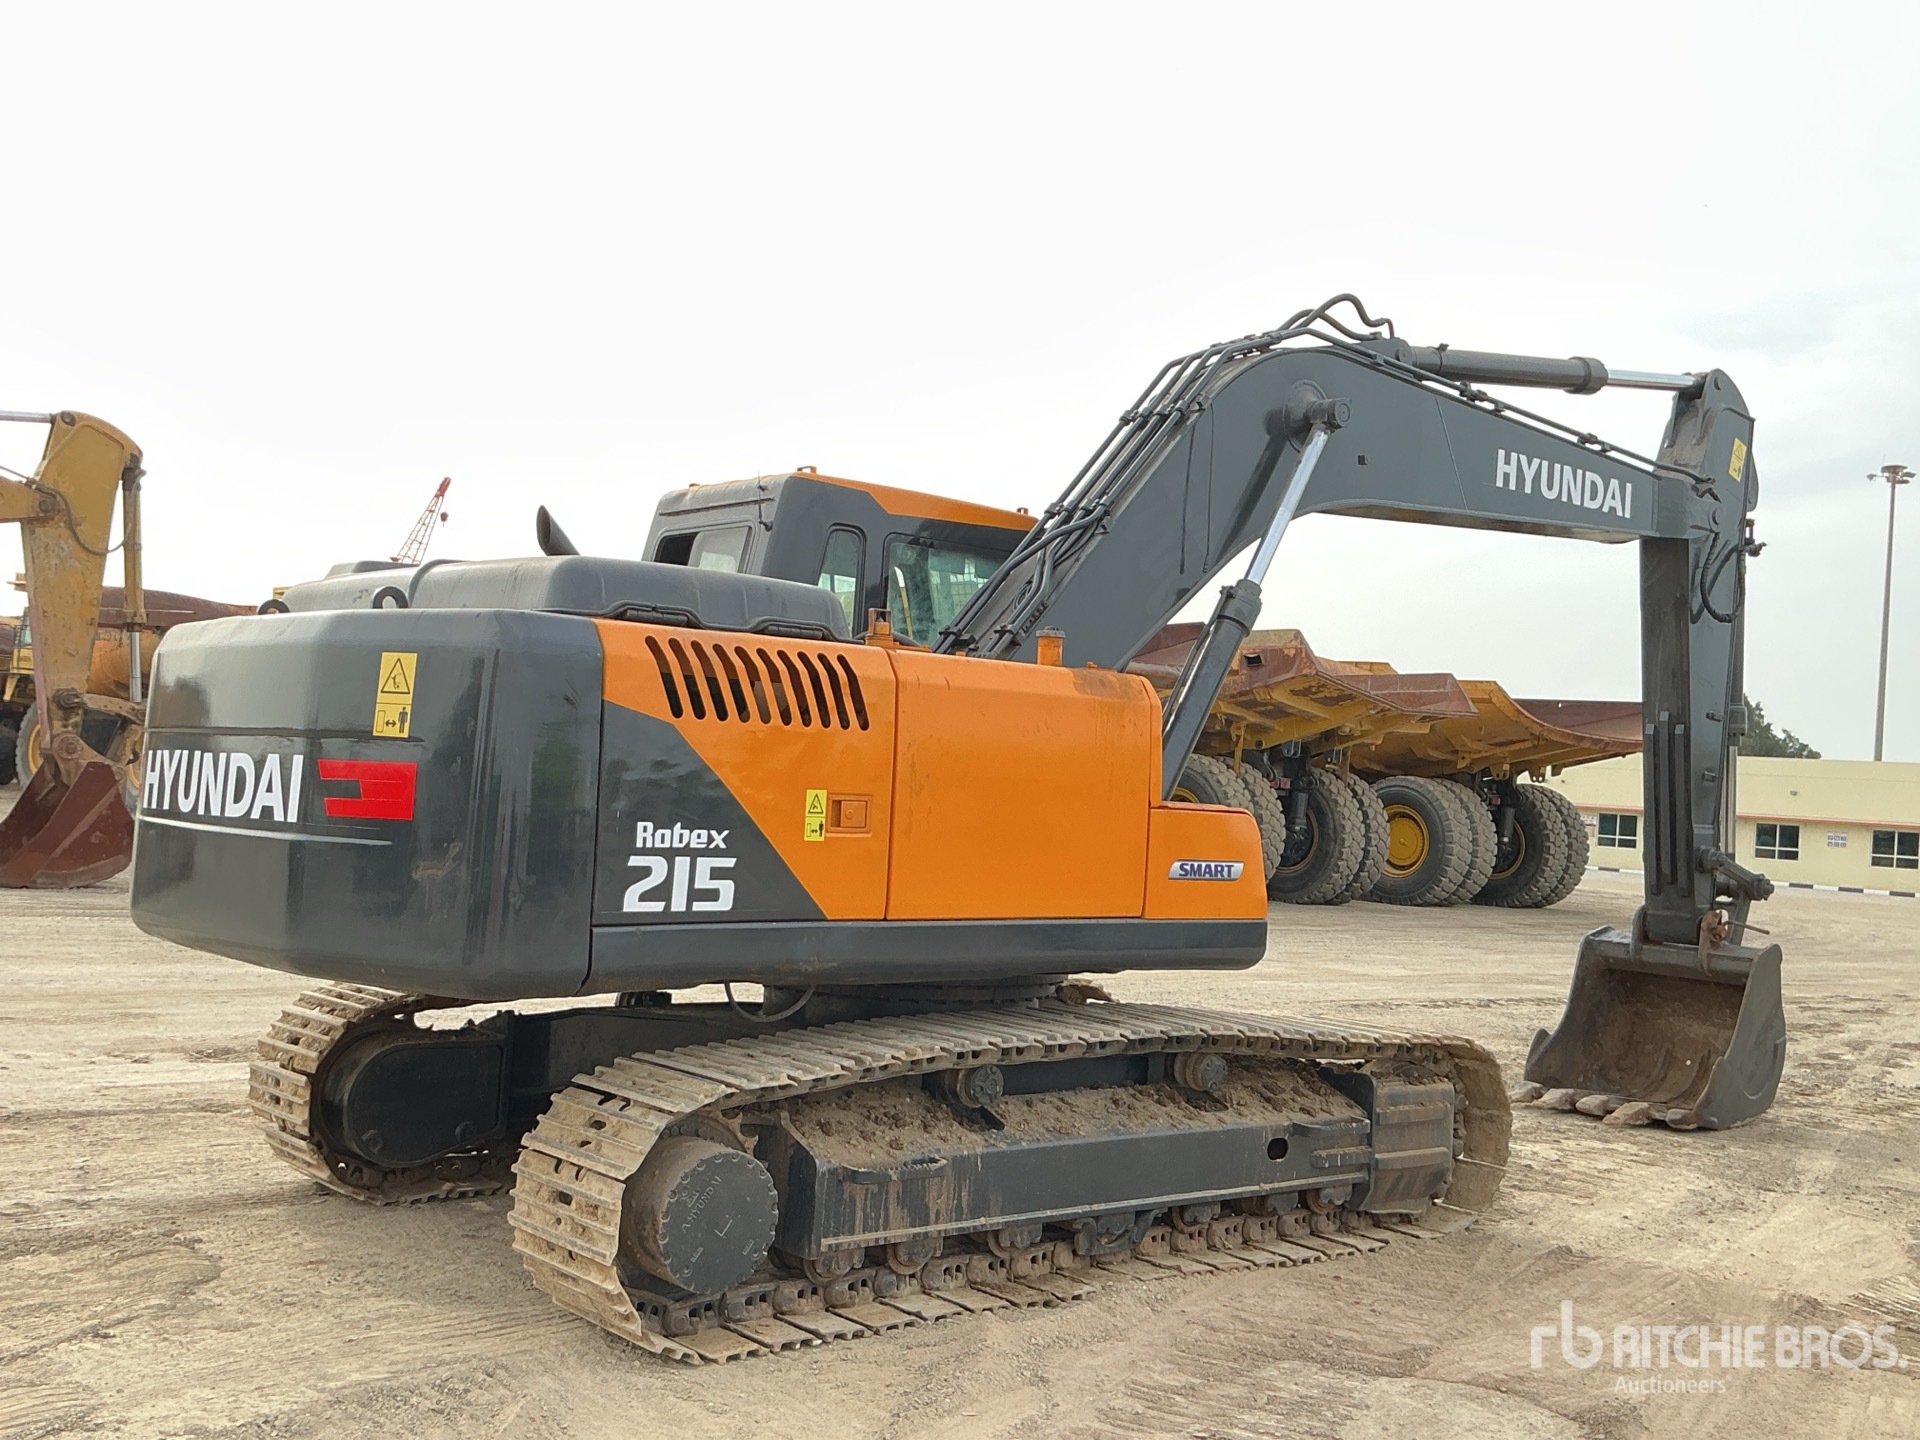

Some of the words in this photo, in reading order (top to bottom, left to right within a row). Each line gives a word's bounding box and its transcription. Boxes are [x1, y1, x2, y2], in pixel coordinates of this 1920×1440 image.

[1495, 449, 1633, 519] HYUNDAI
[142, 749, 304, 823] HYUNDAI
[635, 821, 730, 849] Robex
[622, 855, 738, 912] 215
[1178, 862, 1235, 878] SMART
